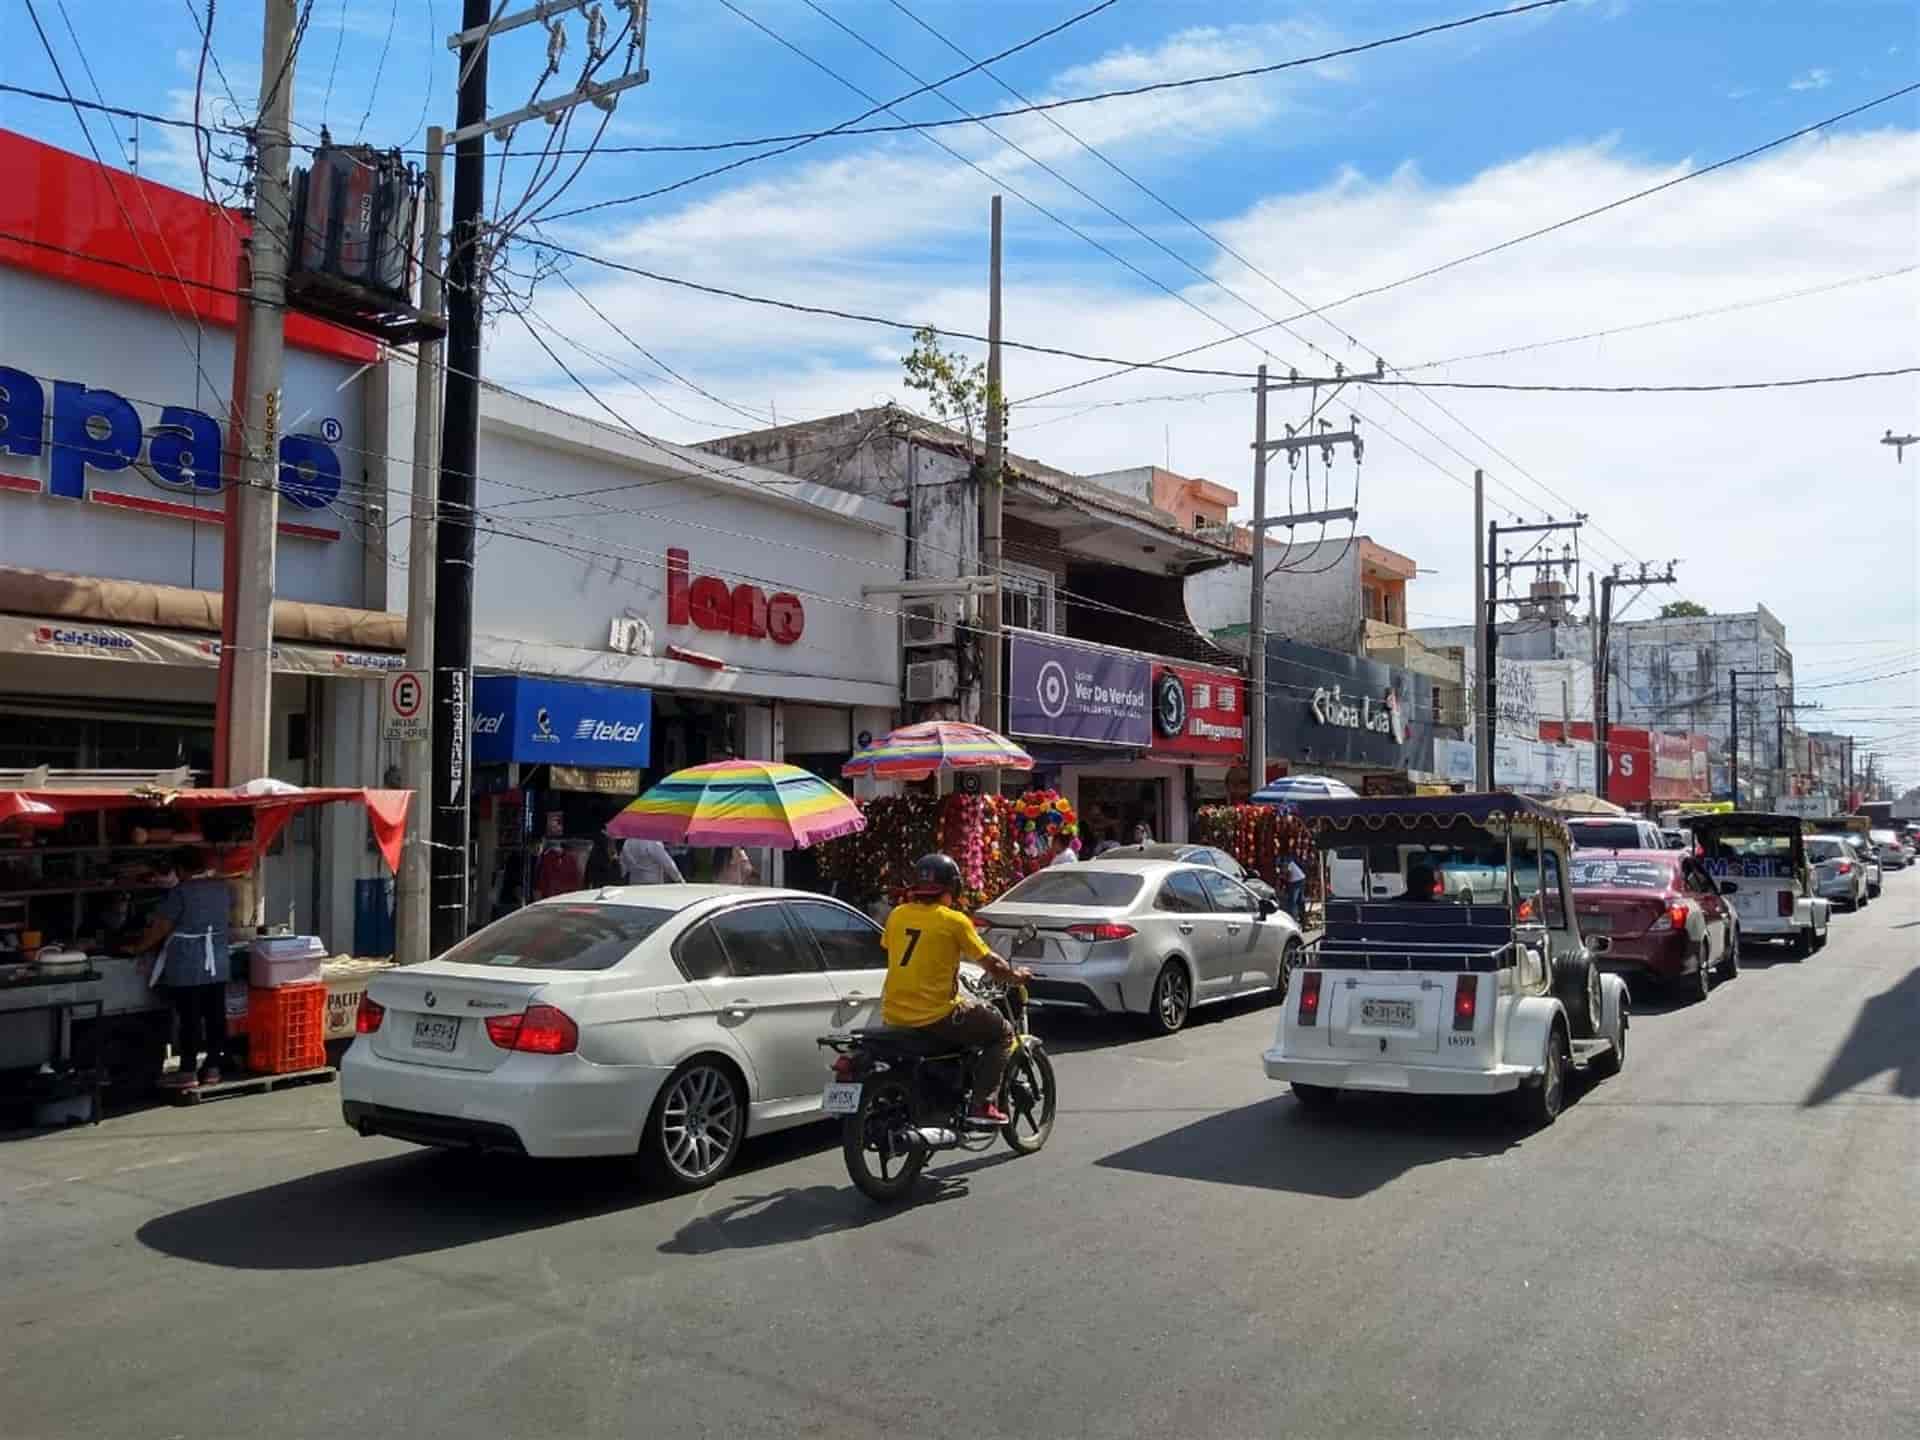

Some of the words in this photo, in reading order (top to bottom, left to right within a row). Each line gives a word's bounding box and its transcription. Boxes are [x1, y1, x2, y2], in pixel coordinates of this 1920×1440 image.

[0, 365, 342, 508] apao
[400, 682, 413, 708] E
[1074, 681, 1093, 700] Ver
[1094, 686, 1109, 703] De
[1109, 688, 1145, 707] Verdad
[592, 720, 645, 742] telcel
[900, 928, 922, 967] 7
